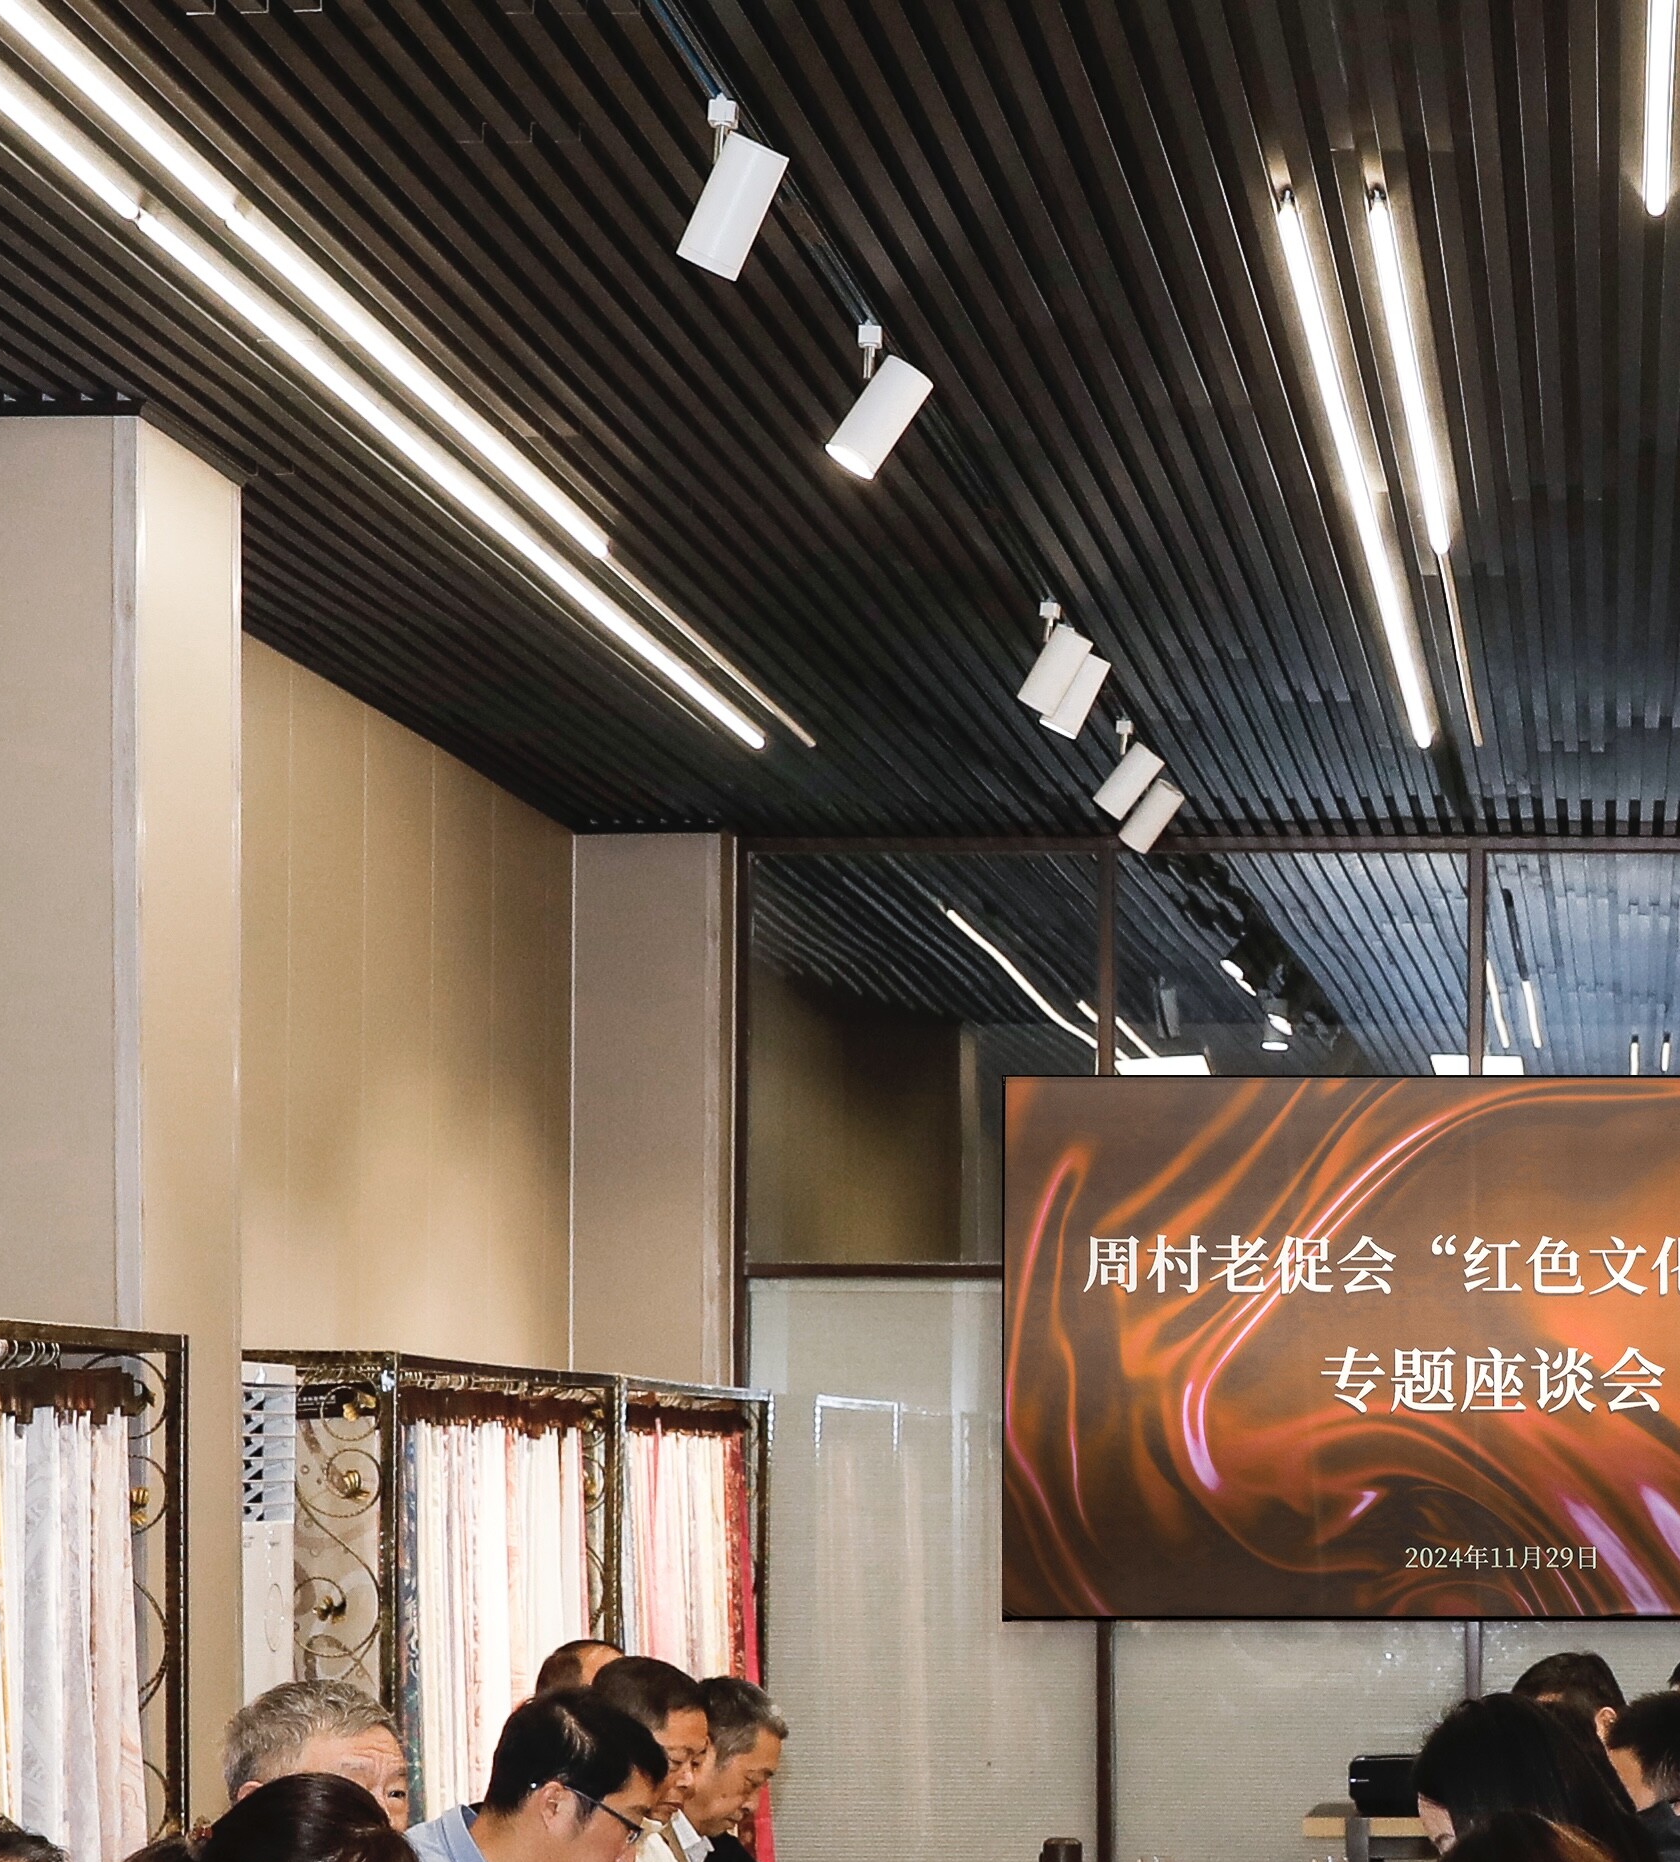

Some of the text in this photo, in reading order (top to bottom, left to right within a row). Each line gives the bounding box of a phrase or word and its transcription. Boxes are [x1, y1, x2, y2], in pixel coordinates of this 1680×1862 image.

[1320, 1346, 1667, 1414] 专题座谈会
[1403, 1544, 1599, 1572] 2024年11月29日
